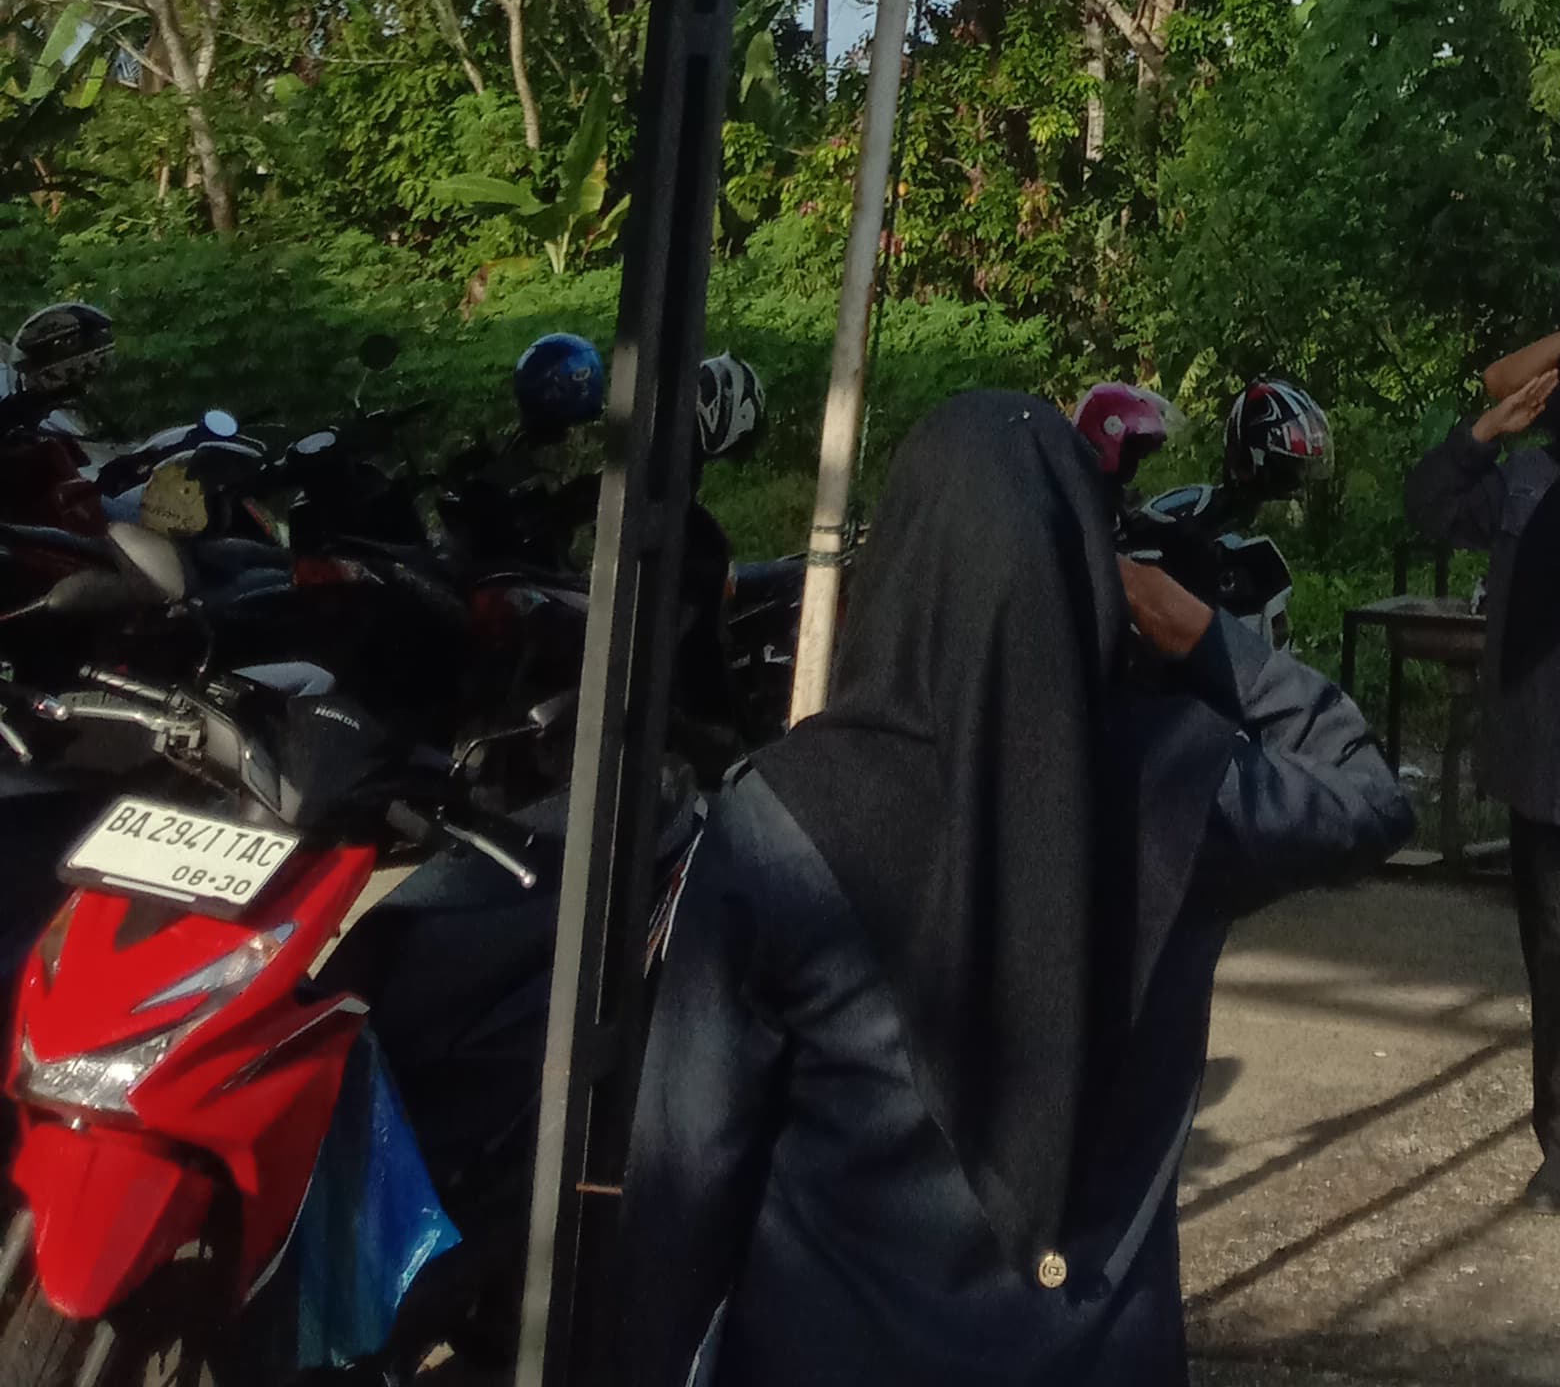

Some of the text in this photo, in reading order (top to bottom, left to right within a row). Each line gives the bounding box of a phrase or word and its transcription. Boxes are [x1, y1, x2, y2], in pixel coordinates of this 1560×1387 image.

[106, 806, 285, 867] BA 2941 TAC
